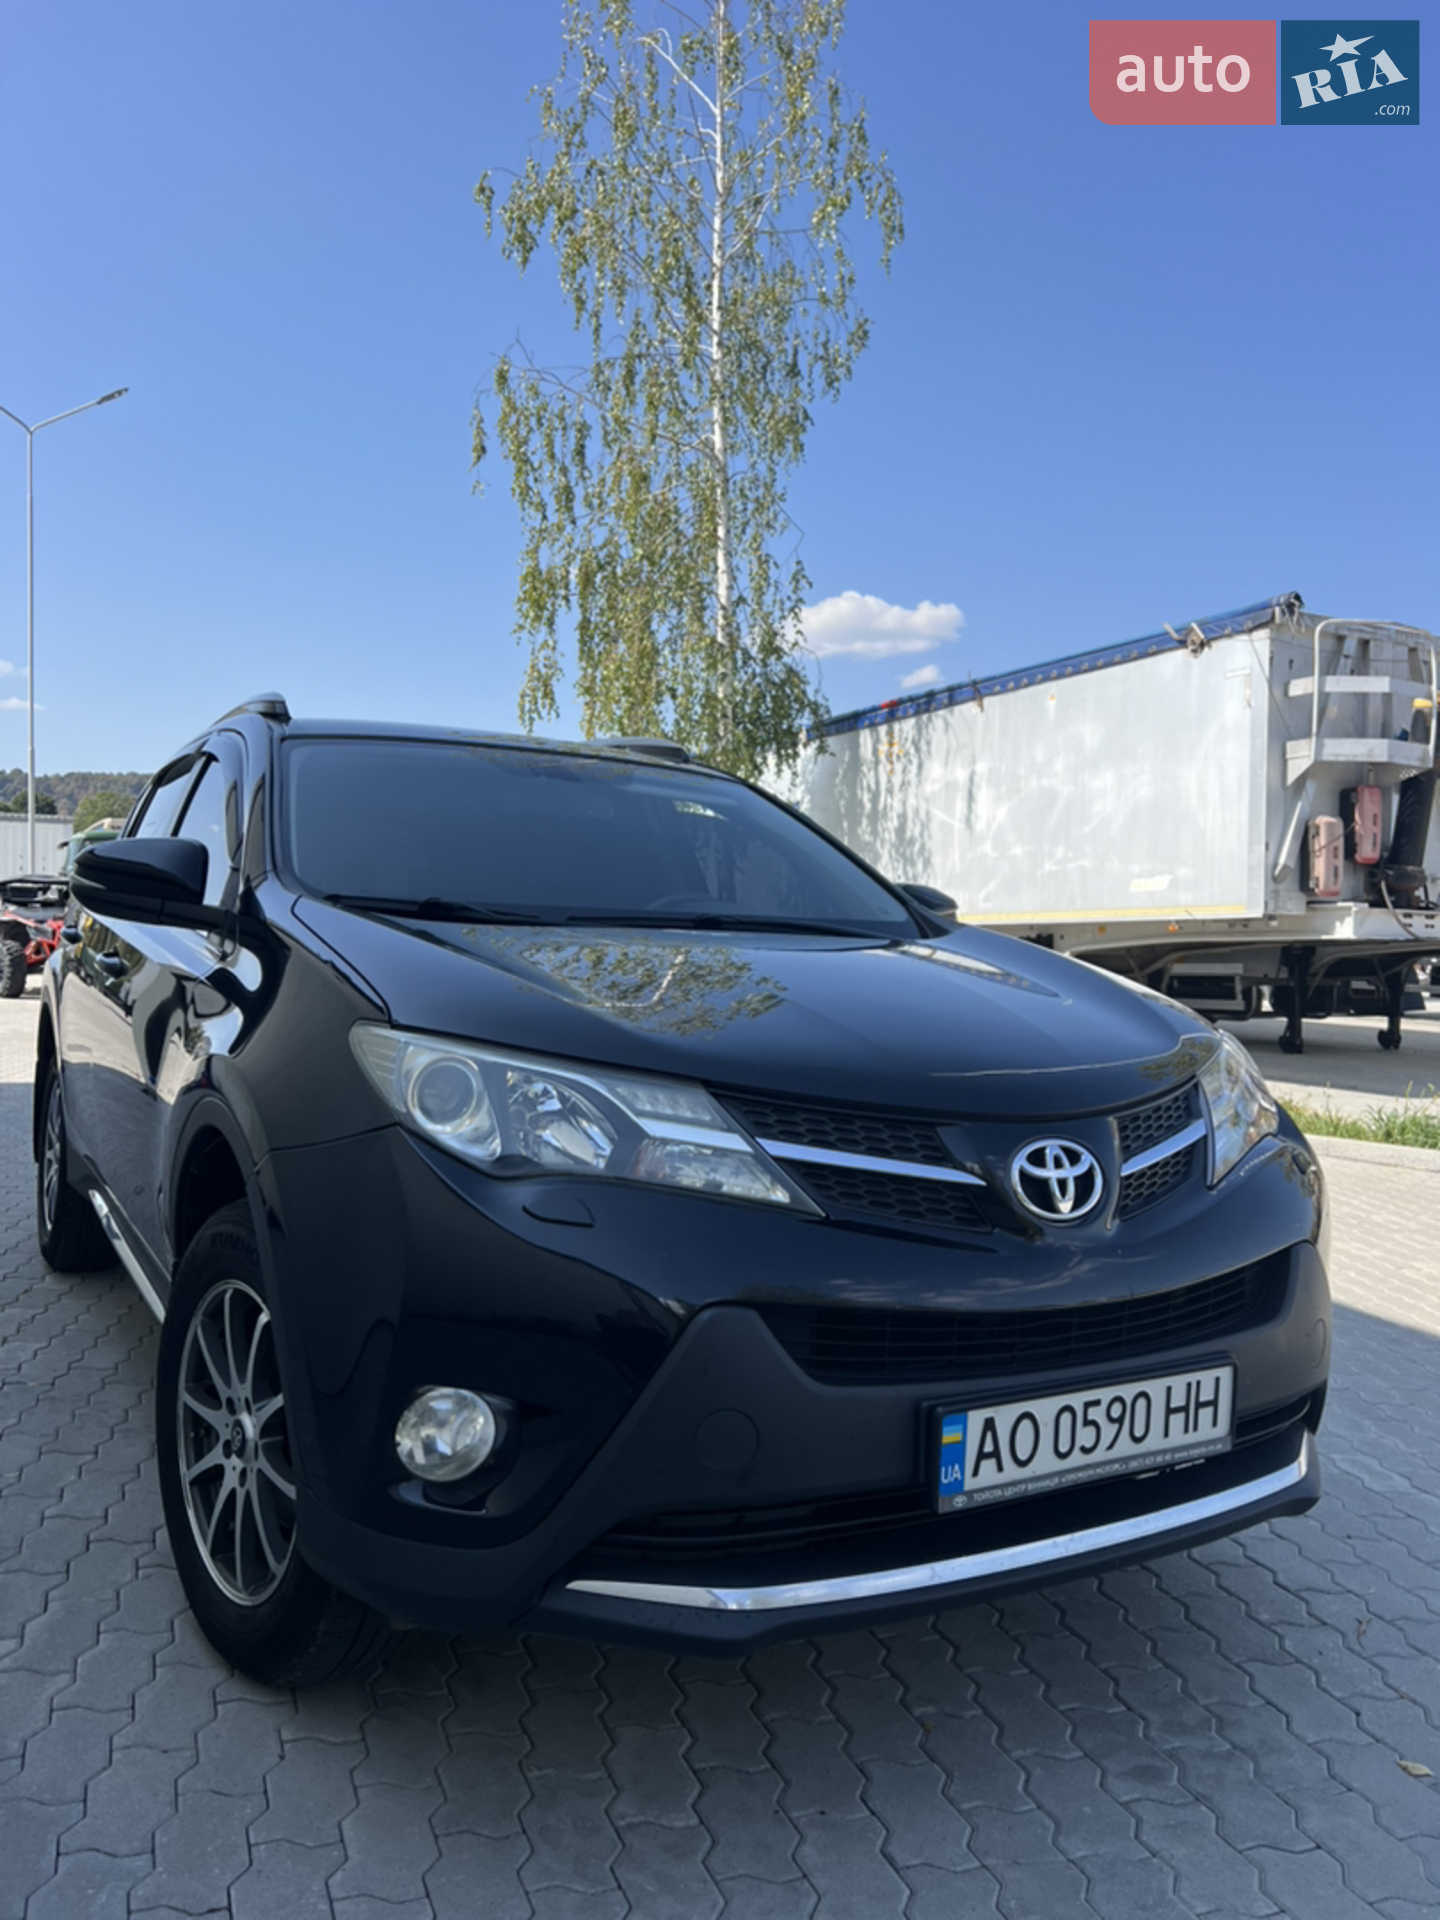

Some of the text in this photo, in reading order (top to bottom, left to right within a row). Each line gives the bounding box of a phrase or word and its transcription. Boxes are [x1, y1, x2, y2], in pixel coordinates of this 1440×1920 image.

[210, 1231, 260, 1267] KUMHO
[971, 1376, 1220, 1478] AO 0590 HH
[940, 1463, 961, 1484] UA
